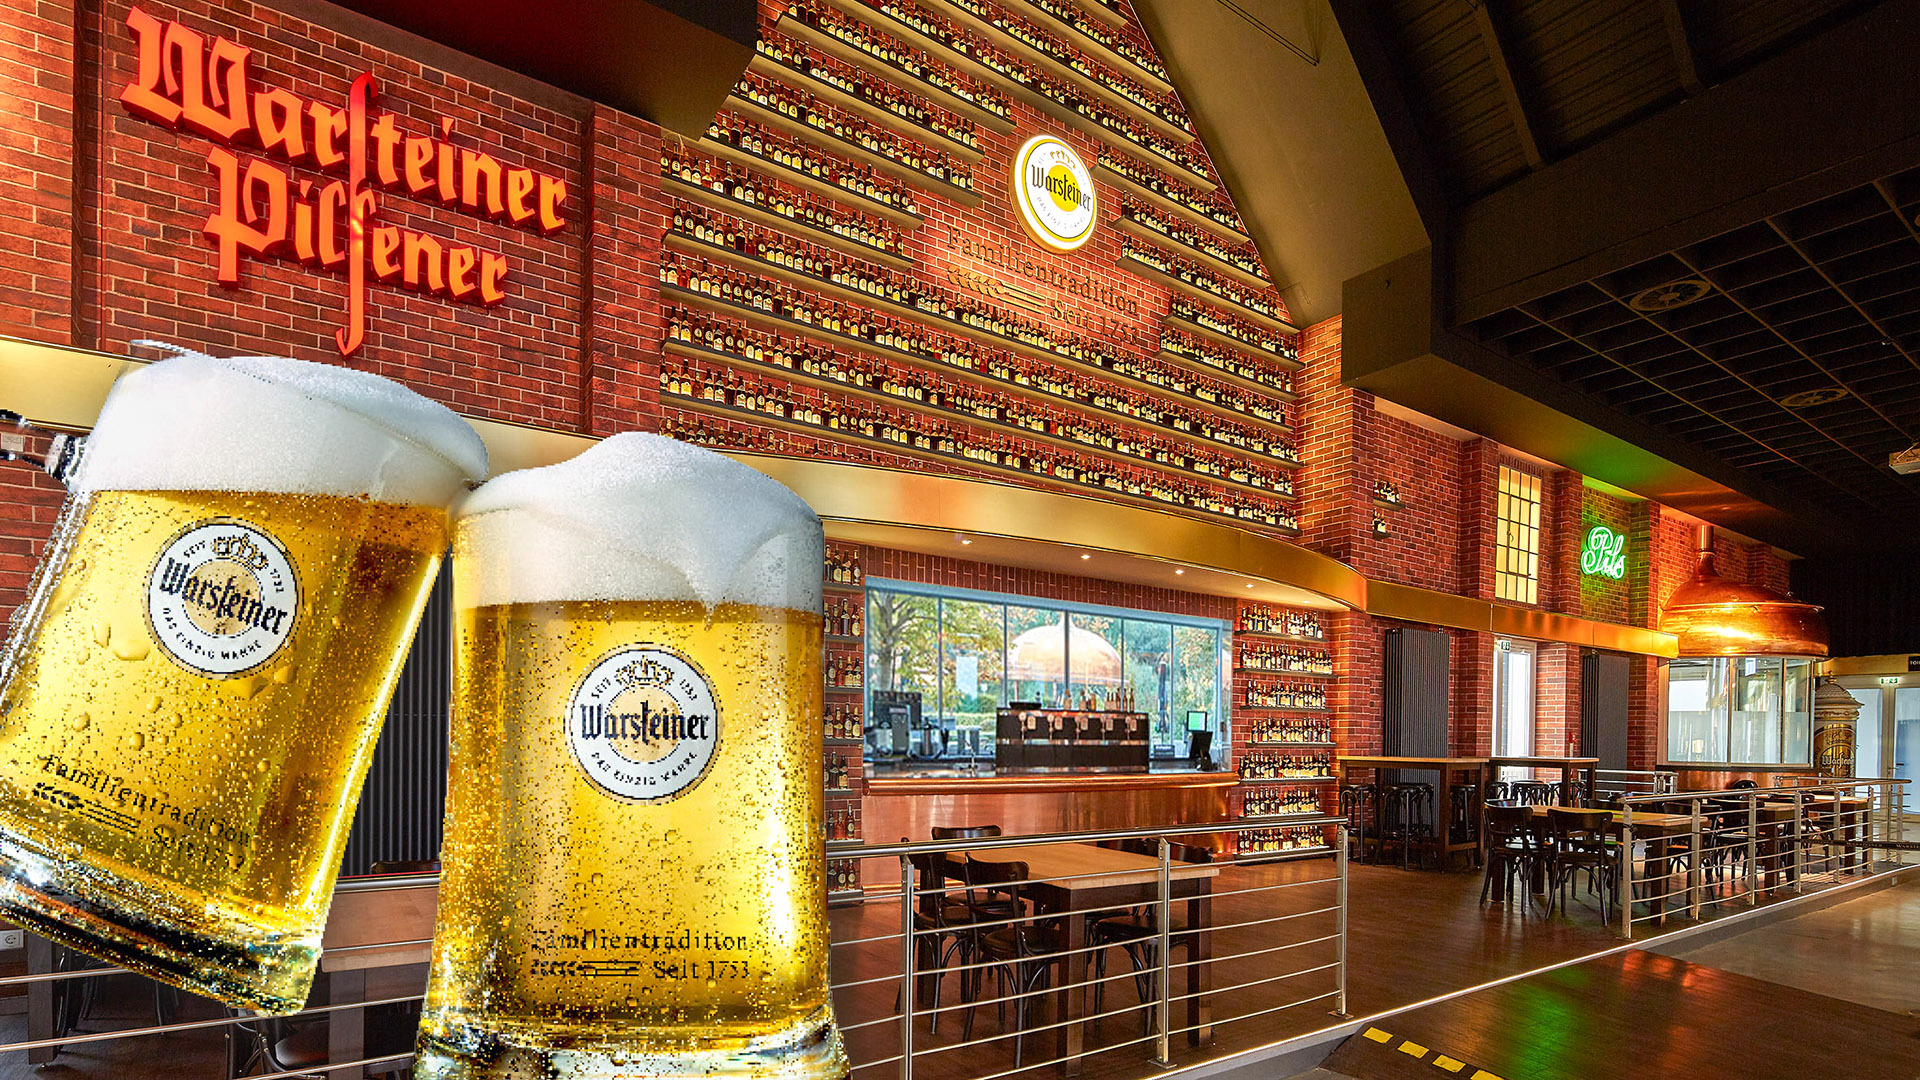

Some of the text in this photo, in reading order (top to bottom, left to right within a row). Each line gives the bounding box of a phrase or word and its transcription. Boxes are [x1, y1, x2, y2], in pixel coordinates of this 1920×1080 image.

[119, 5, 568, 238] Warsteiner
[1032, 164, 1091, 212] Warsteiner
[202, 146, 509, 357] Pilsener
[947, 225, 1138, 317] Familientradition
[1051, 298, 1139, 345] Seit 1753
[1581, 526, 1626, 579] Pils
[160, 556, 288, 635] Warsteiner
[580, 699, 710, 746] Warsteiner
[531, 929, 748, 951] Familientradition
[653, 959, 750, 980] Seit 1753
